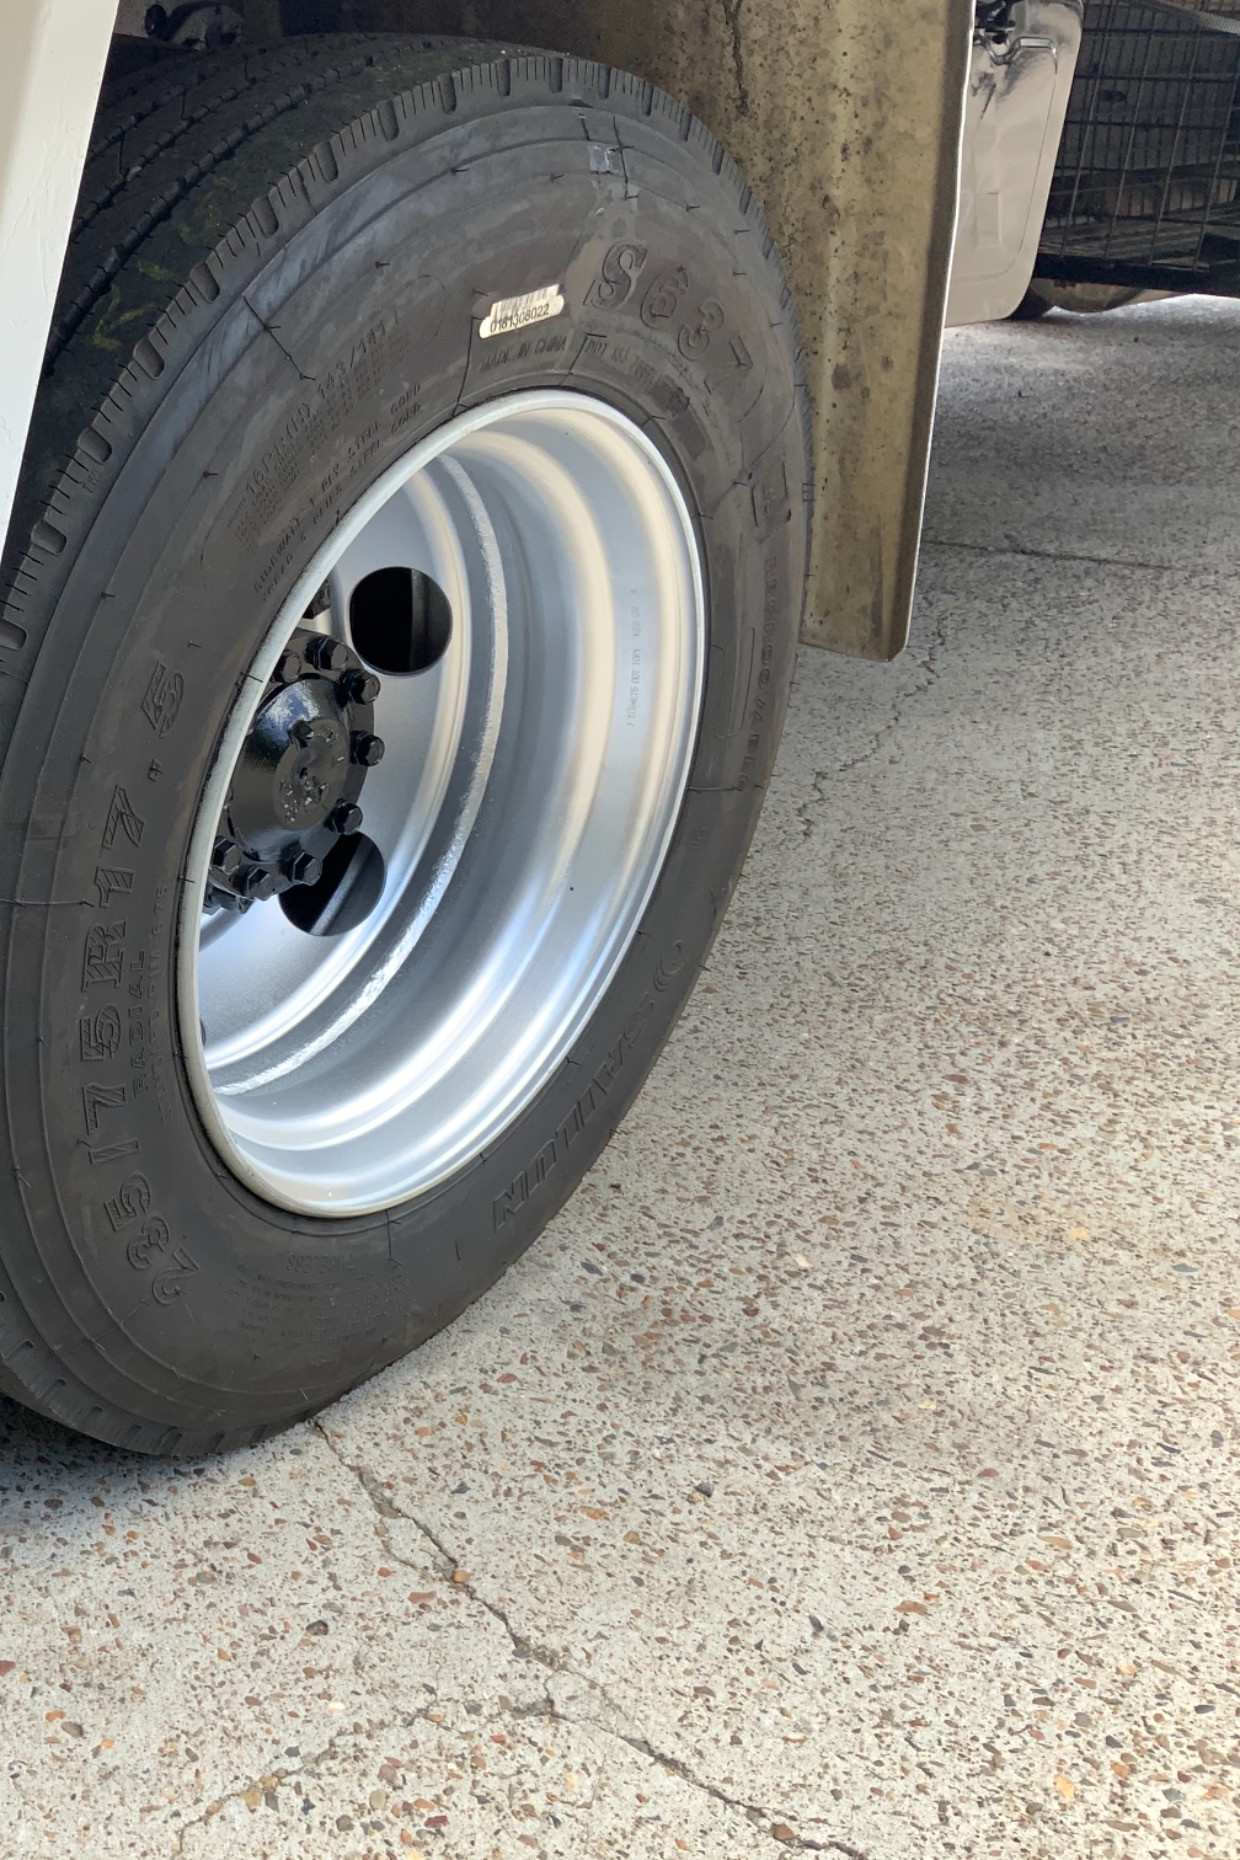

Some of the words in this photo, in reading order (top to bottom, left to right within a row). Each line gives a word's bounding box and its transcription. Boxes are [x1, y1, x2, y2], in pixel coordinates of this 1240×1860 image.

[517, 342, 531, 359] IN
[584, 243, 753, 394] S637
[129, 950, 148, 1098] RADIAL
